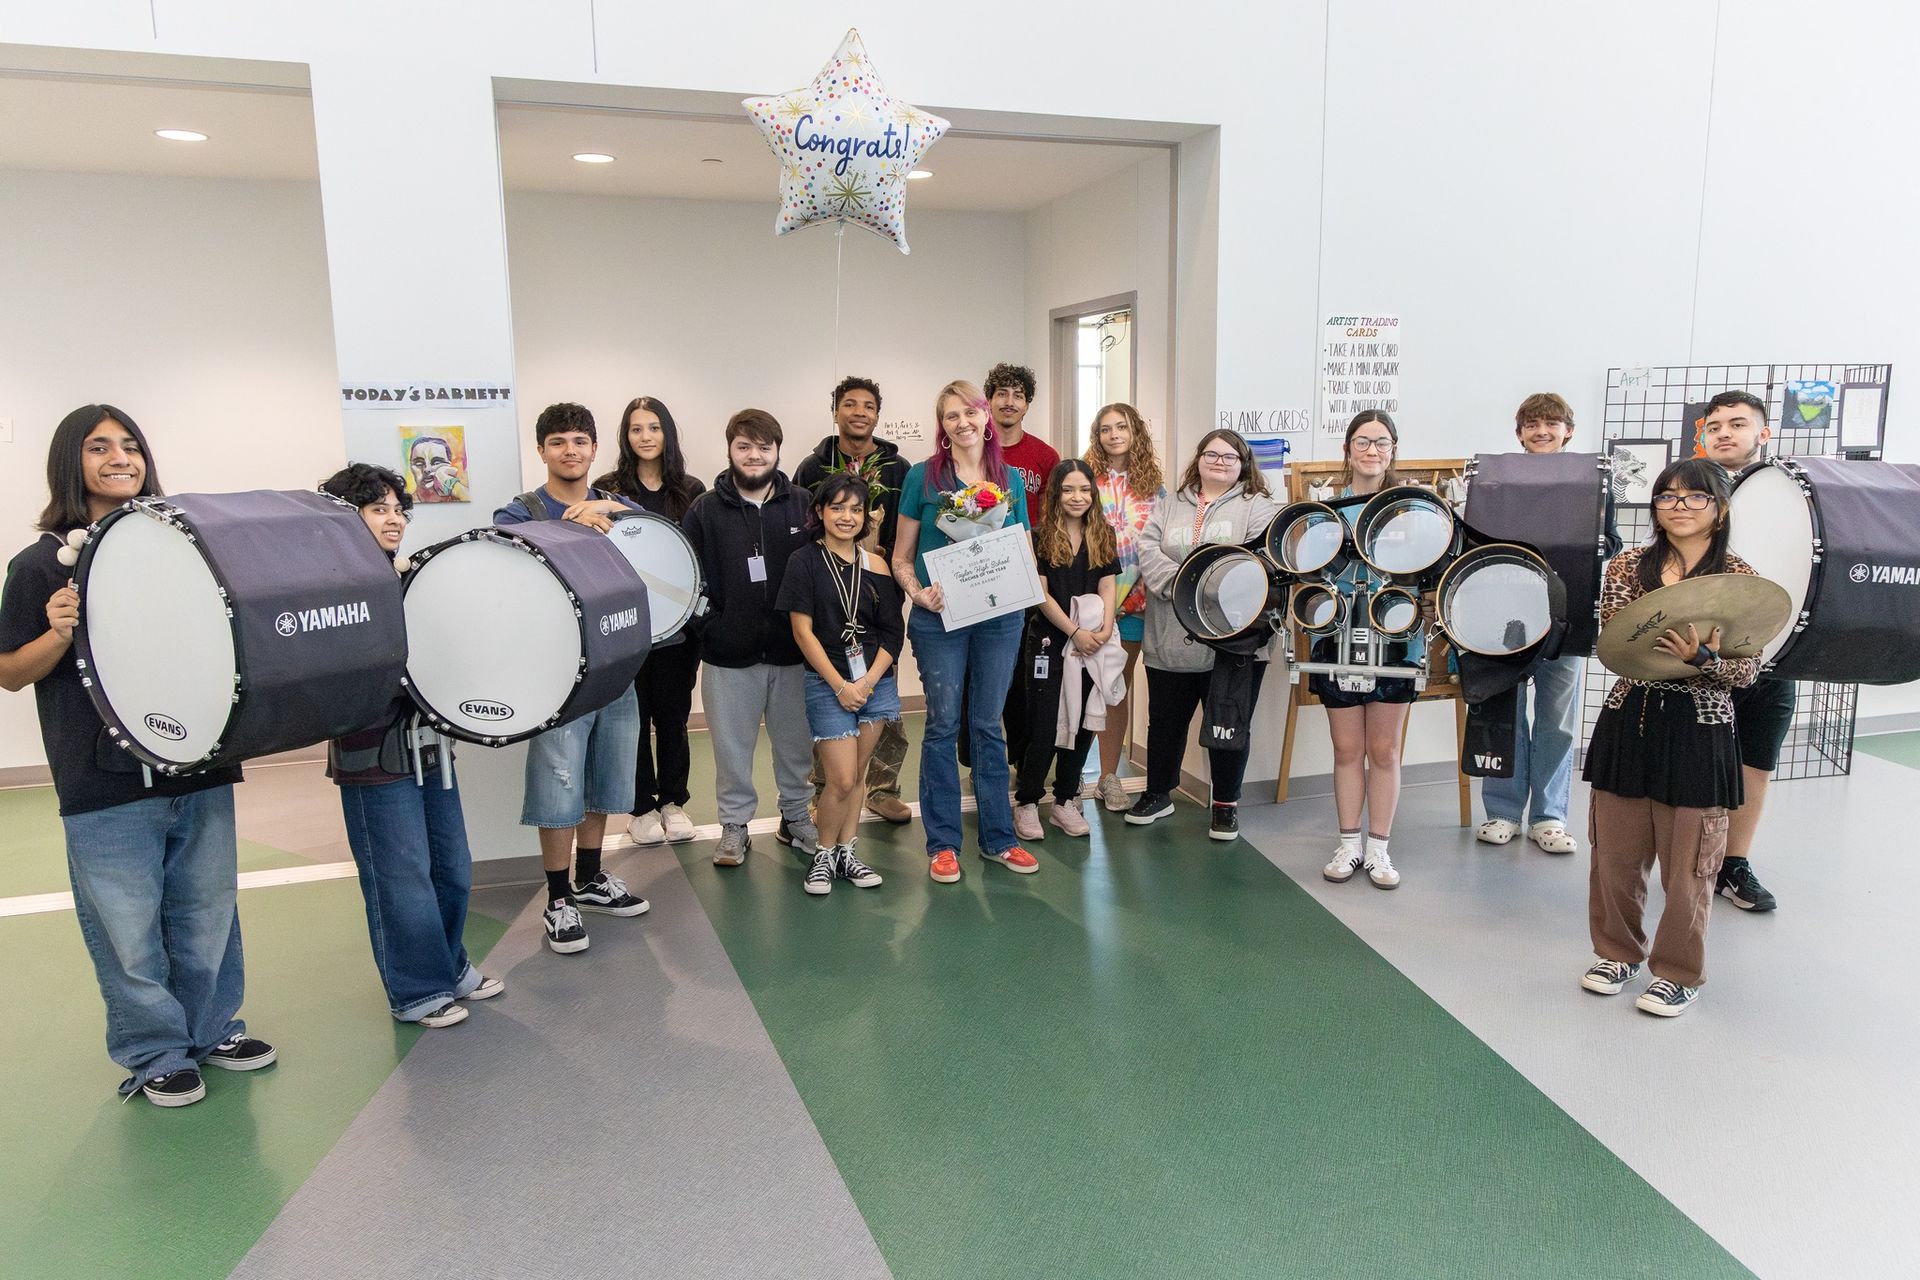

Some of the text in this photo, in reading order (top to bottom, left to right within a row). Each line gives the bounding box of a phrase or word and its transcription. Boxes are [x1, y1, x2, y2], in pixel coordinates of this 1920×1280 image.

[795, 114, 910, 176] Congrats!
[1326, 316, 1399, 327] ARTIST TRADING
[1346, 328, 1378, 337] CARDS
[1329, 343, 1398, 357] TAKE A BLANK CARD
[1327, 361, 1399, 376] MAKE A MINI ARTWORK
[425, 387, 511, 400] BARNETT
[1328, 380, 1391, 395] TRADE YOUR CARD
[1328, 399, 1347, 413] WITH
[1380, 399, 1398, 413] CARD
[1219, 409, 1310, 432] BLANK CARDS
[953, 556, 1010, 579] Taylor High School
[959, 574, 979, 583] TEACHER
[297, 601, 371, 633] YAMAHA
[609, 607, 638, 632] YAMAHA
[465, 704, 507, 716] EVANS
[149, 717, 181, 736] EVANS
